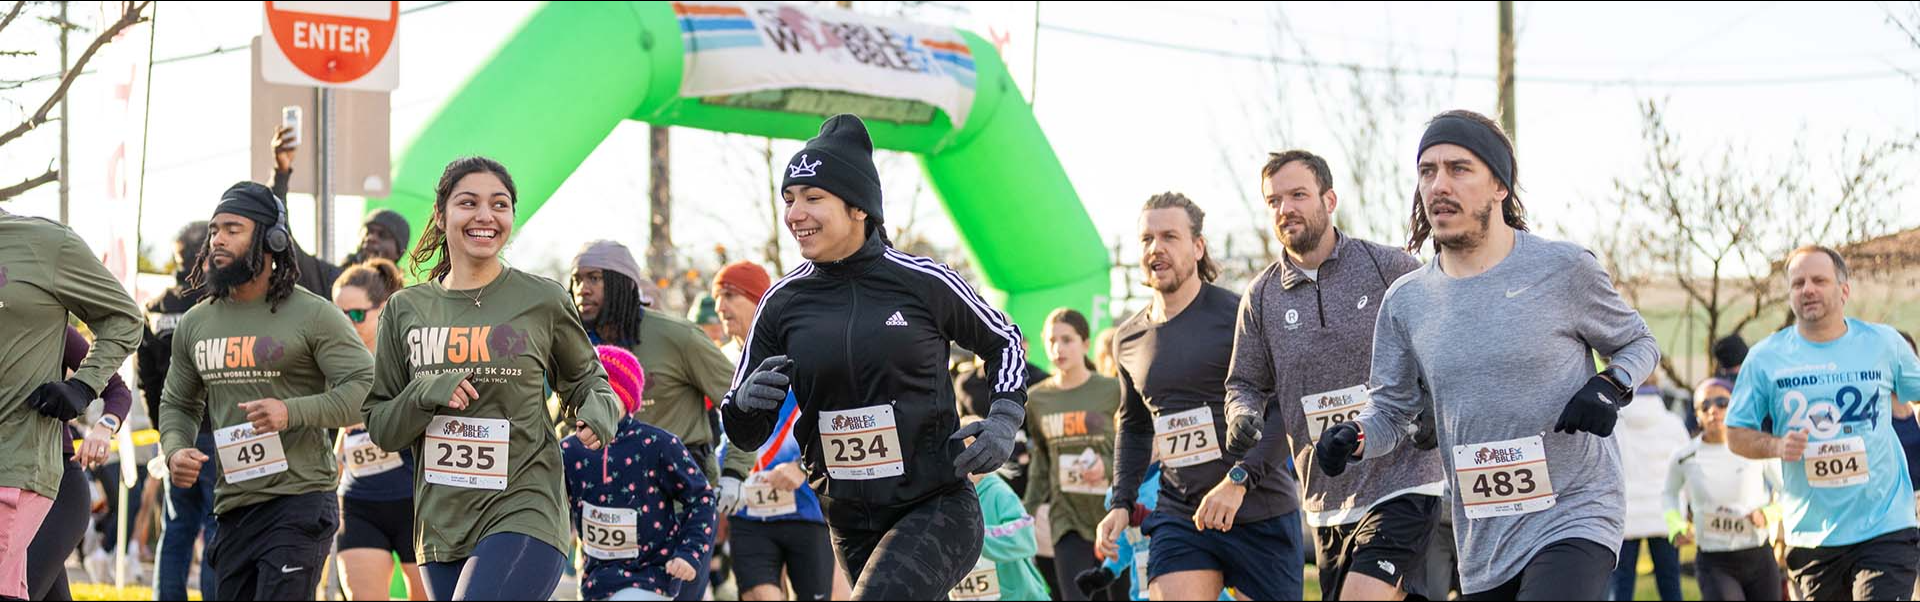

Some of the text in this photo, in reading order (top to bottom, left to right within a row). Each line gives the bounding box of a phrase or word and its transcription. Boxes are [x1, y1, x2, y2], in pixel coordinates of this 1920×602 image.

[293, 21, 370, 57] ENTER
[194, 336, 256, 371] GW5K
[406, 326, 491, 368] GW5K
[485, 367, 497, 375] 5K
[500, 367, 522, 376] 2025
[237, 442, 266, 465] 49
[831, 434, 889, 462] 234
[1167, 430, 1208, 454] 773
[437, 443, 495, 470] 235
[1814, 457, 1859, 477] 804
[1473, 468, 1536, 498] 483
[755, 488, 779, 504] 14
[586, 524, 627, 547] 529
